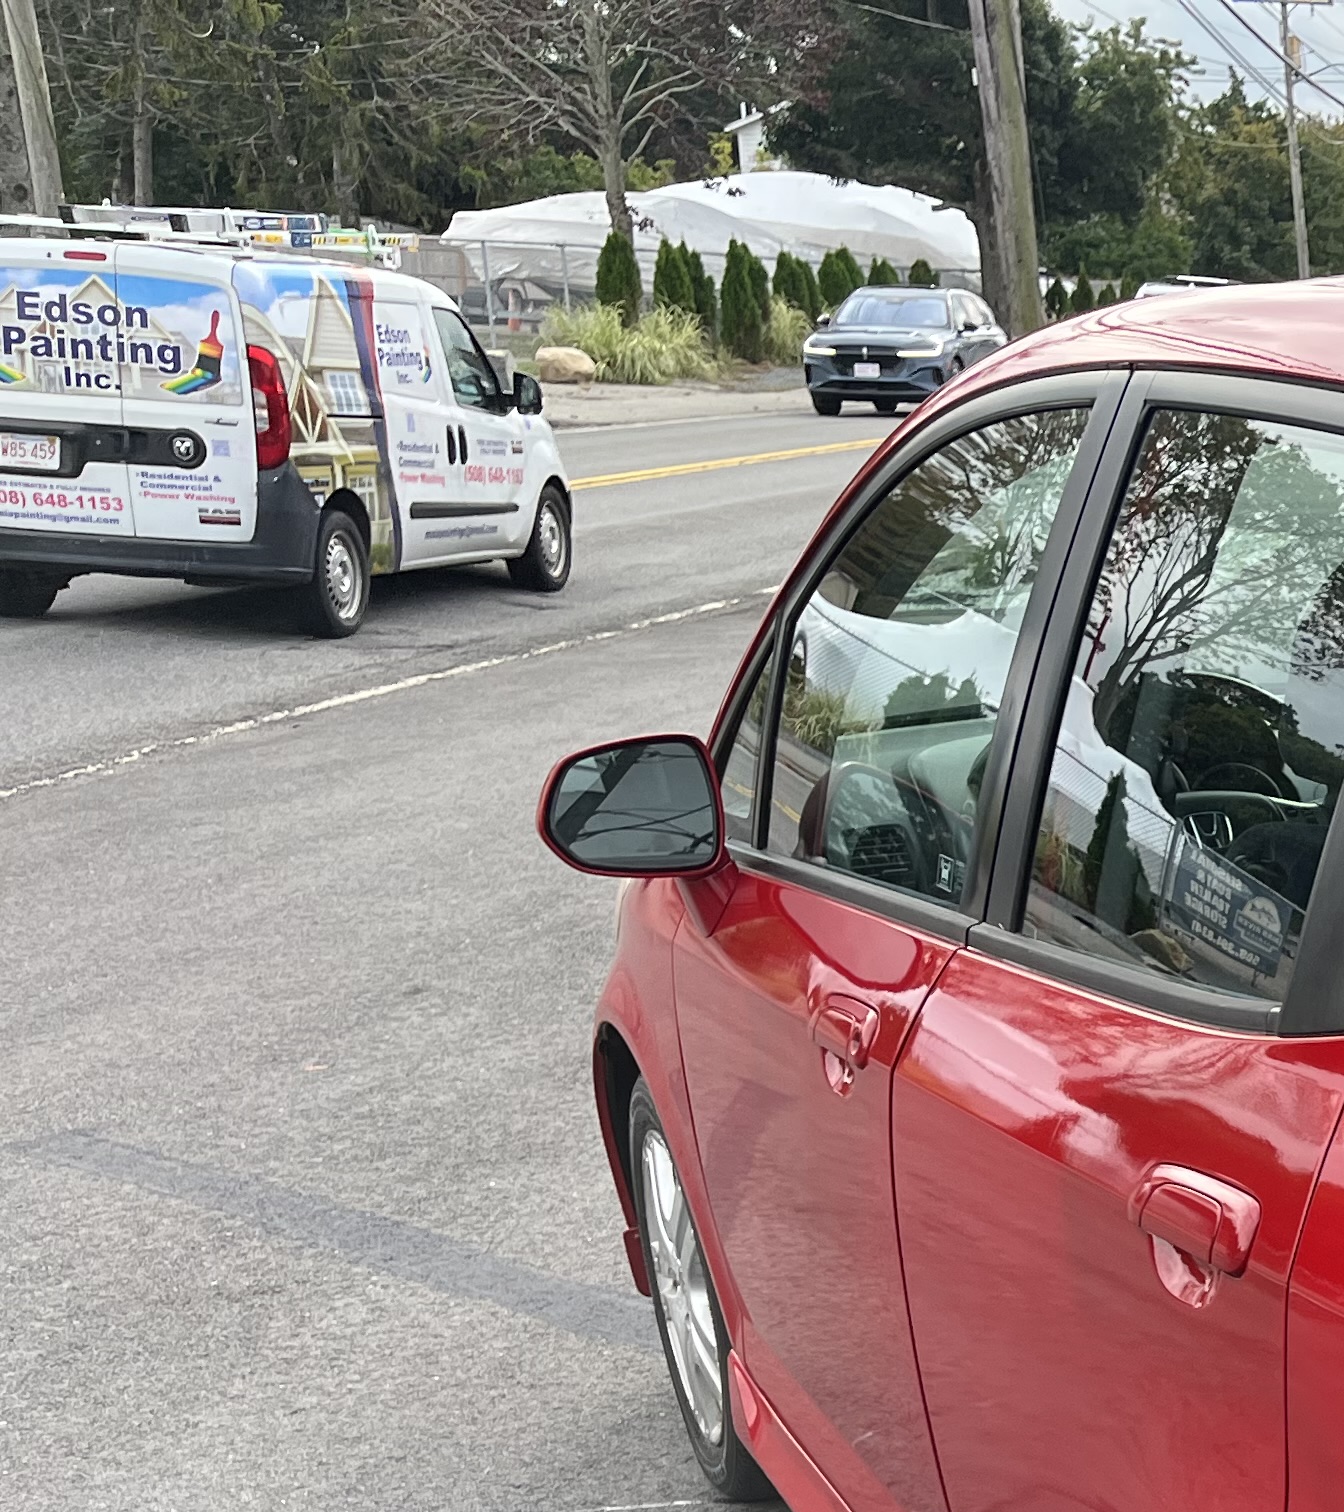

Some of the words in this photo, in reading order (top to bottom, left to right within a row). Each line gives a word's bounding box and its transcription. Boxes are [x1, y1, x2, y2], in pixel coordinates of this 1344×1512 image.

[16, 290, 149, 329] Edson
[375, 323, 411, 344] Edson
[2, 325, 182, 374] Painting
[377, 346, 423, 371] Painting
[64, 366, 122, 391] Inc.
[140, 481, 213, 492] Commercial
[141, 471, 209, 482] Residential
[213, 475, 222, 483] &
[33, 491, 124, 512] 648-1153
[143, 490, 180, 500] Power
[184, 492, 236, 505] Washing
